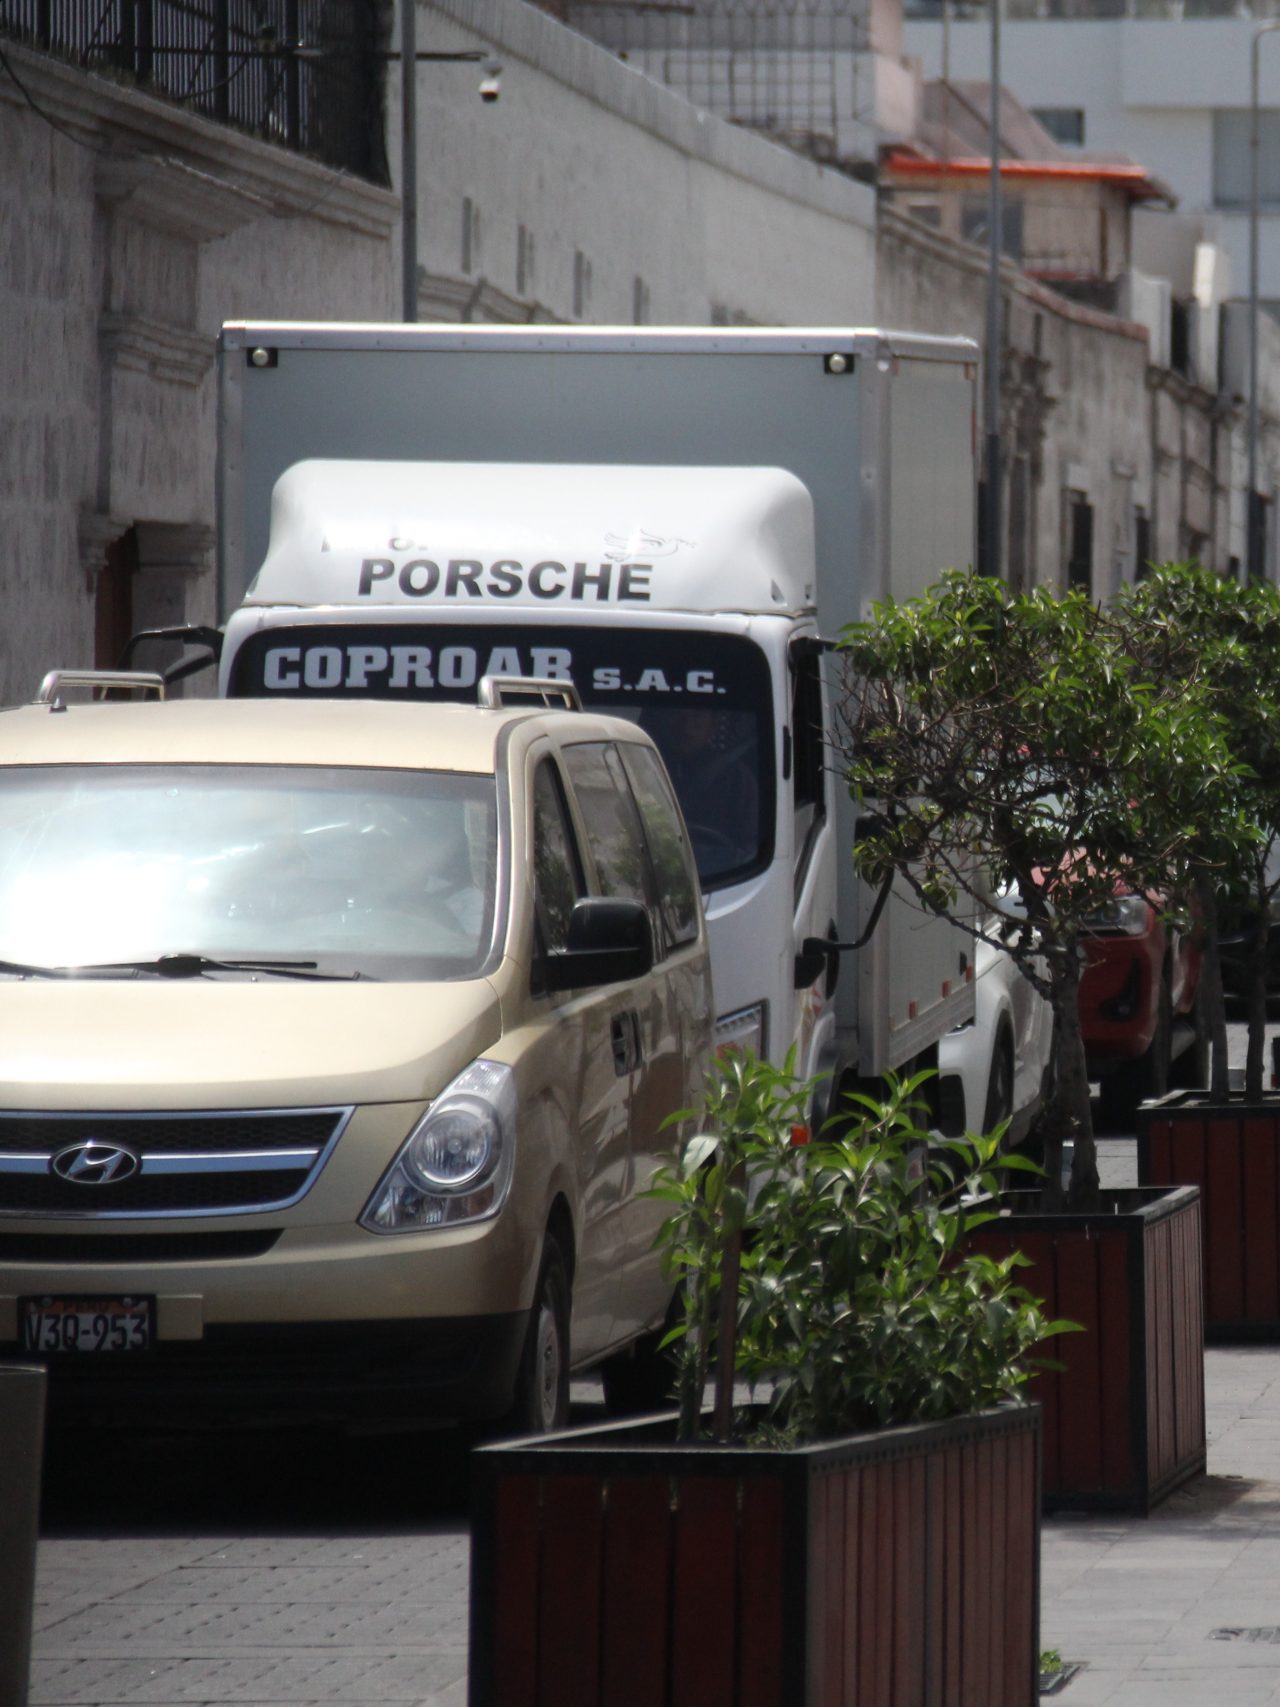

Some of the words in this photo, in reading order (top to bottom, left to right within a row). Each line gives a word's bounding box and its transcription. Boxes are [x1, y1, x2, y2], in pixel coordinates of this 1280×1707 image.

[358, 558, 653, 601] PORSCHE
[264, 645, 572, 689] COPROAR
[593, 666, 727, 694] S.A.C.
[26, 1313, 147, 1351] V3Q-953
